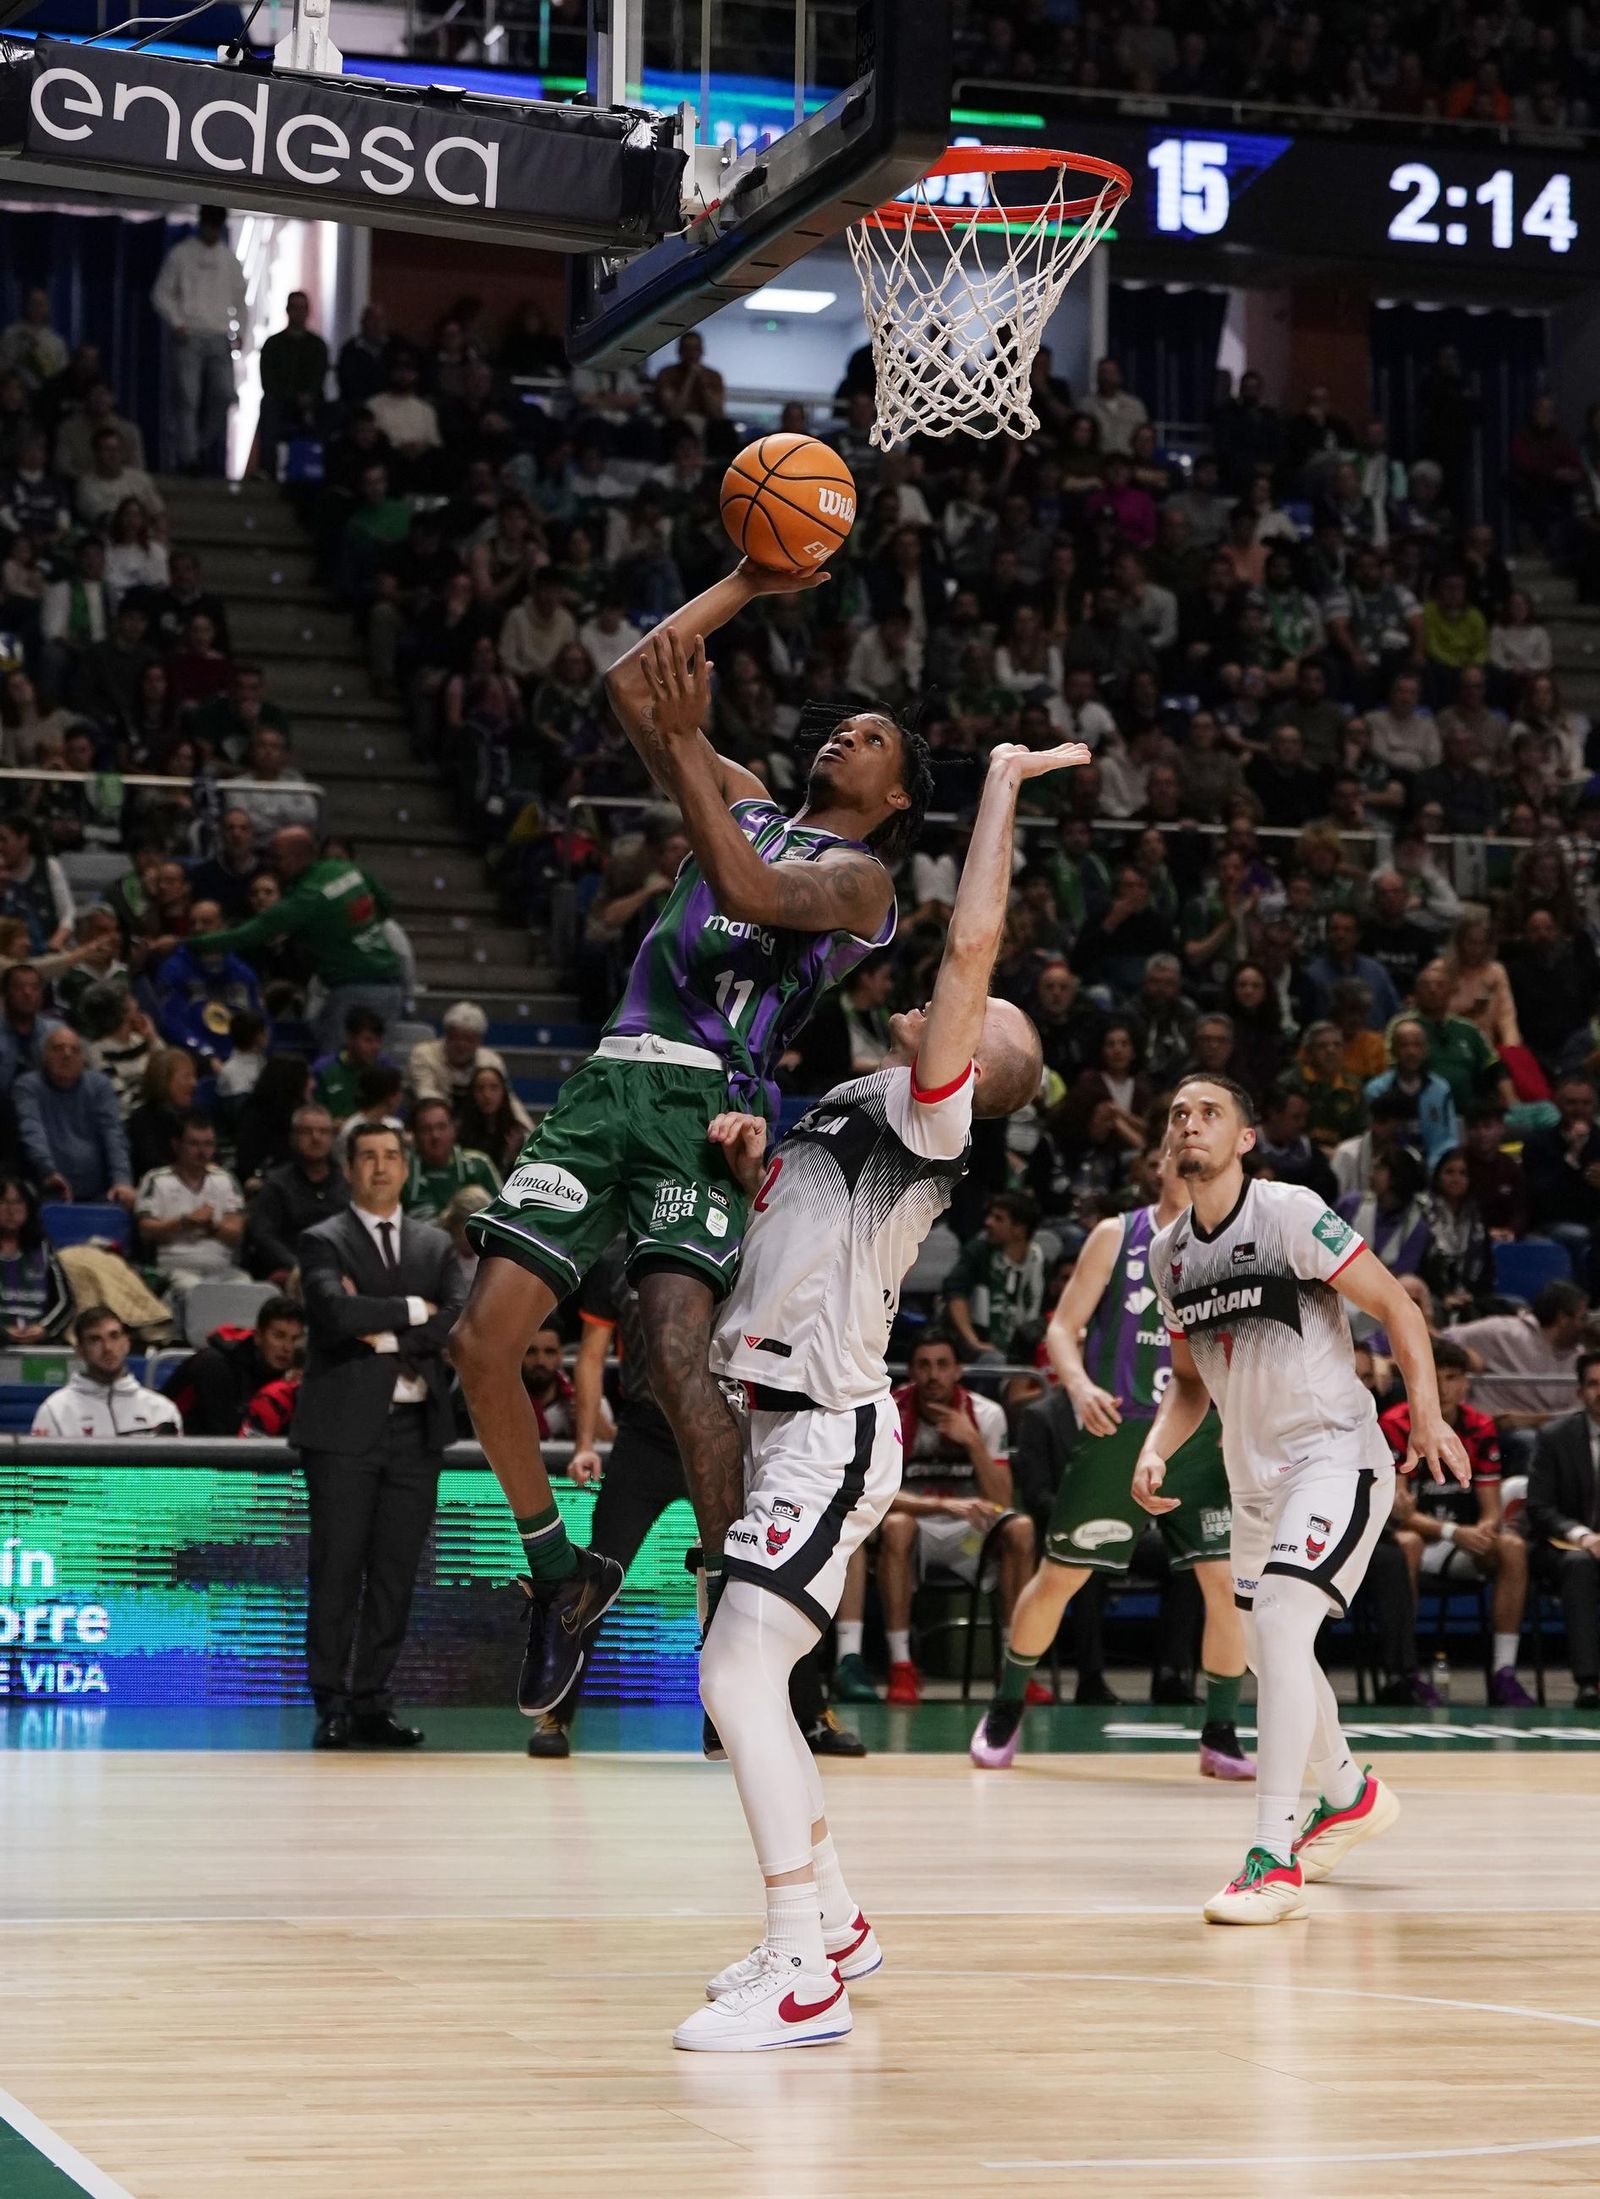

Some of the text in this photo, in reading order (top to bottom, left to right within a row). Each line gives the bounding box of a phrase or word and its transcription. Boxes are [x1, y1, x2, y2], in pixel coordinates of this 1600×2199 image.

[30, 67, 500, 209] endesa
[1148, 138, 1230, 235] 15
[1388, 162, 1578, 253] 2:14
[714, 969, 755, 1029] 11
[652, 1200, 695, 1223] laga
[711, 1191, 728, 1206] acb
[754, 1156, 784, 1213] 2
[774, 1505, 794, 1516] acb
[21, 1660, 110, 1693] VIDA
